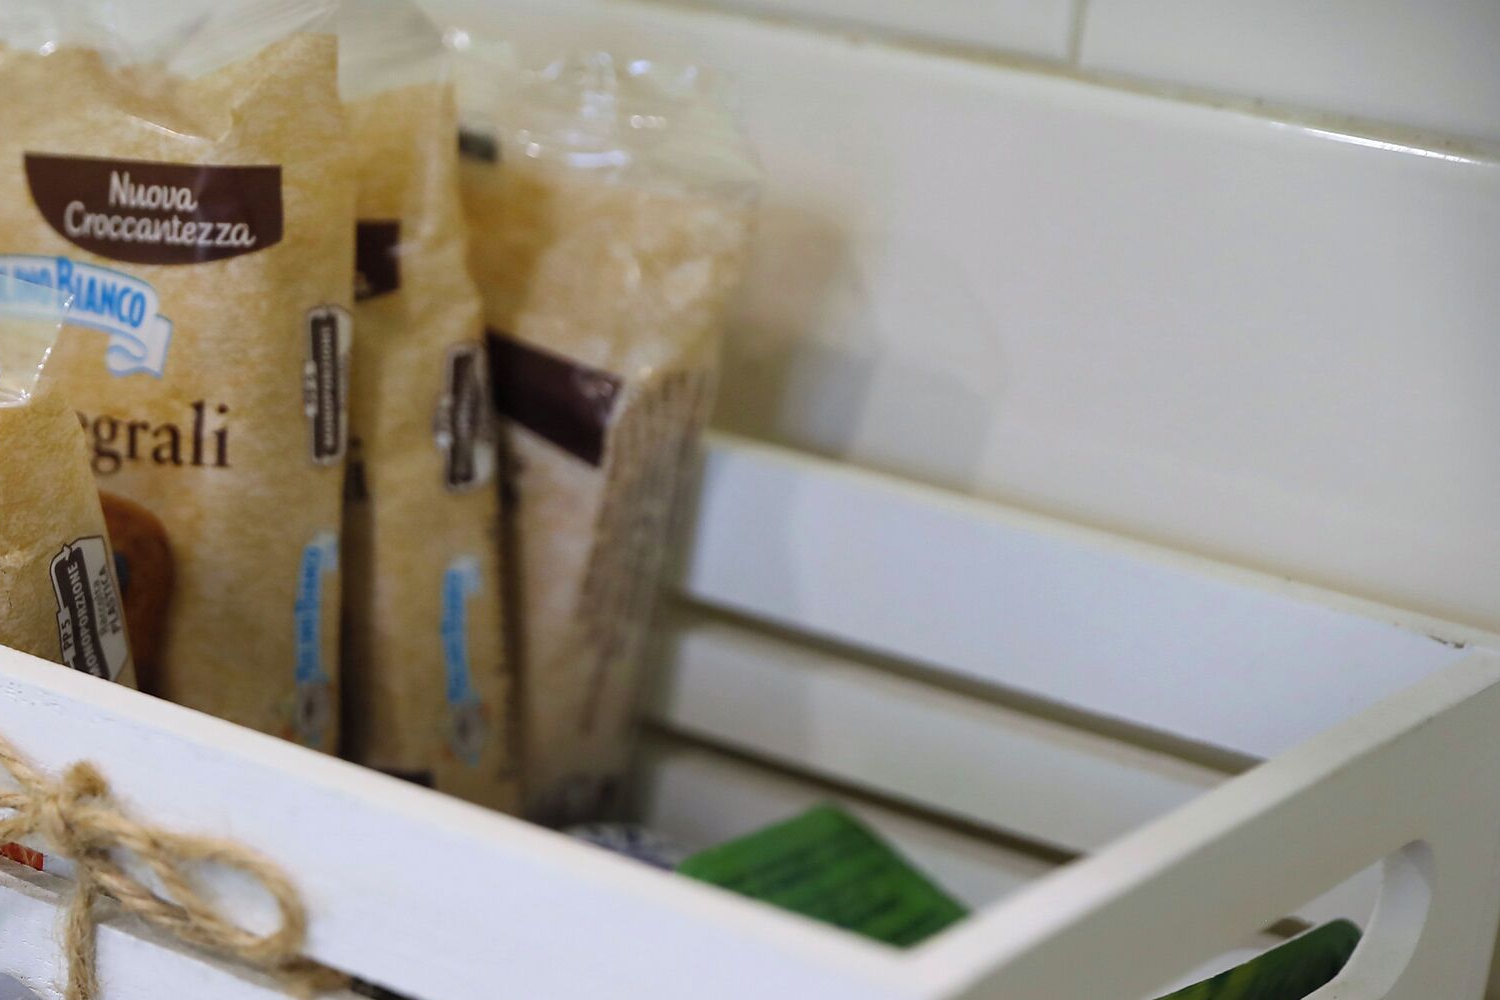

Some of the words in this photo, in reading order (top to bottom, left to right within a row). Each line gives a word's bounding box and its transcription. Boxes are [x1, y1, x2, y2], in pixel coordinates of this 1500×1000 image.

[63, 200, 257, 248] Croccantezza
[109, 170, 198, 212] Nuova
[55, 256, 147, 329] BIANCO
[75, 400, 232, 476] grali
[67, 560, 102, 678] MONOPORZIONE
